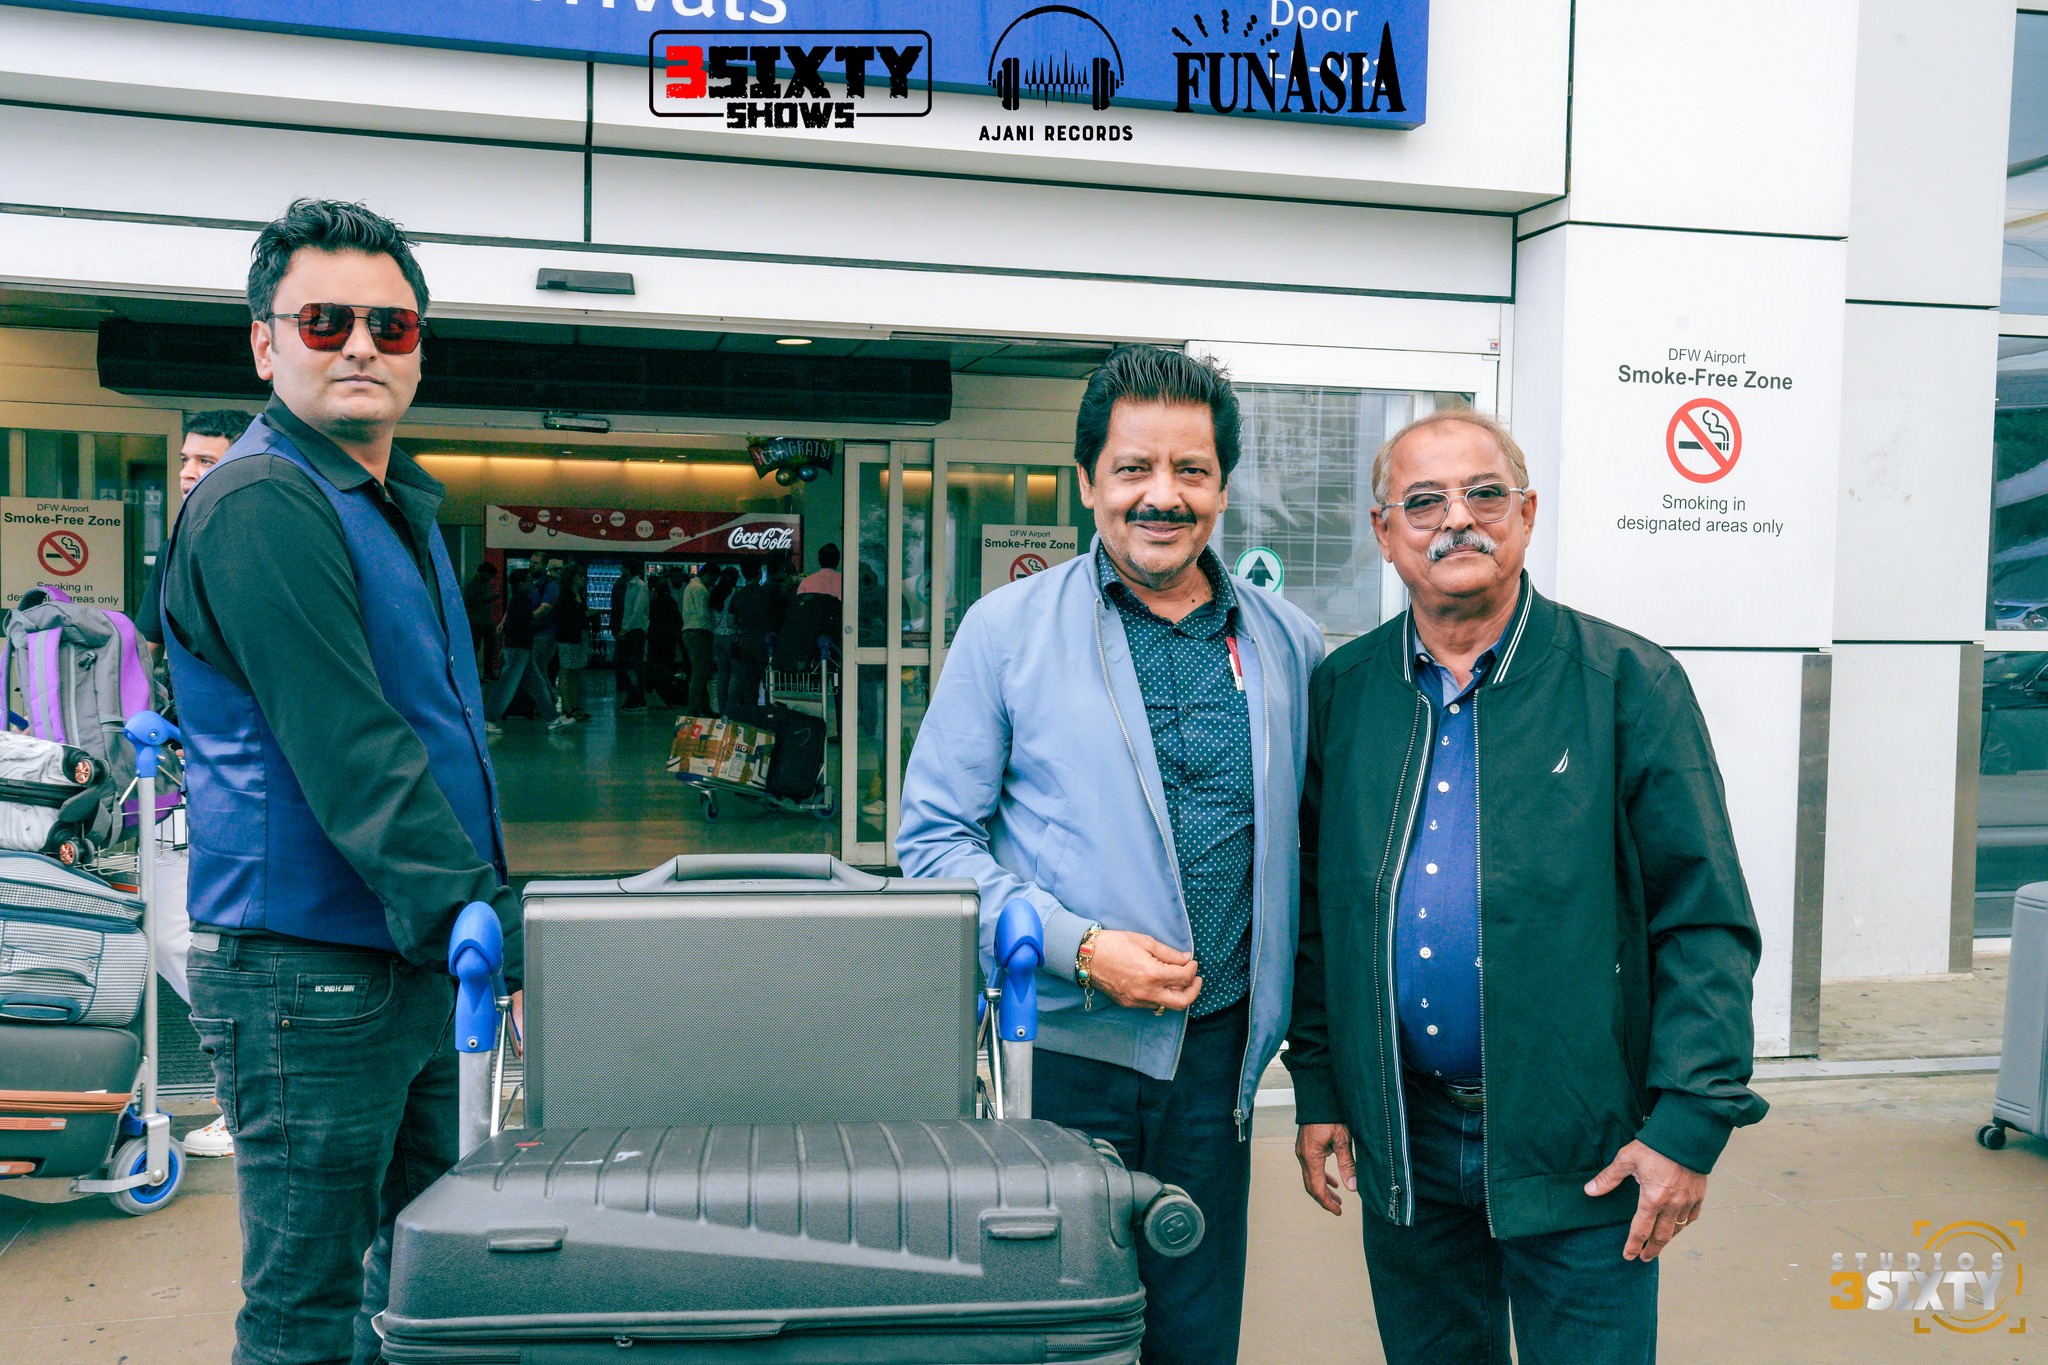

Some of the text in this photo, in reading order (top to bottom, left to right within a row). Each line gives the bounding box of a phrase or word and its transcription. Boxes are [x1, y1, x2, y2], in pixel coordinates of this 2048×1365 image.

[1270, 0, 1358, 33] Door
[1668, 347, 1747, 366] DFW Airport
[1617, 364, 1793, 390] Smoke-Free Zone
[37, 503, 89, 513] DFW Airport
[1662, 494, 1746, 515] Smoking in
[3, 512, 122, 527] Smoke-Free Zone
[1616, 515, 1784, 537] designated areas only
[1009, 529, 1051, 539] DFW Airport
[984, 538, 1076, 550] Smoke-Free Zone
[84, 582, 94, 592] in
[97, 595, 120, 606] only
